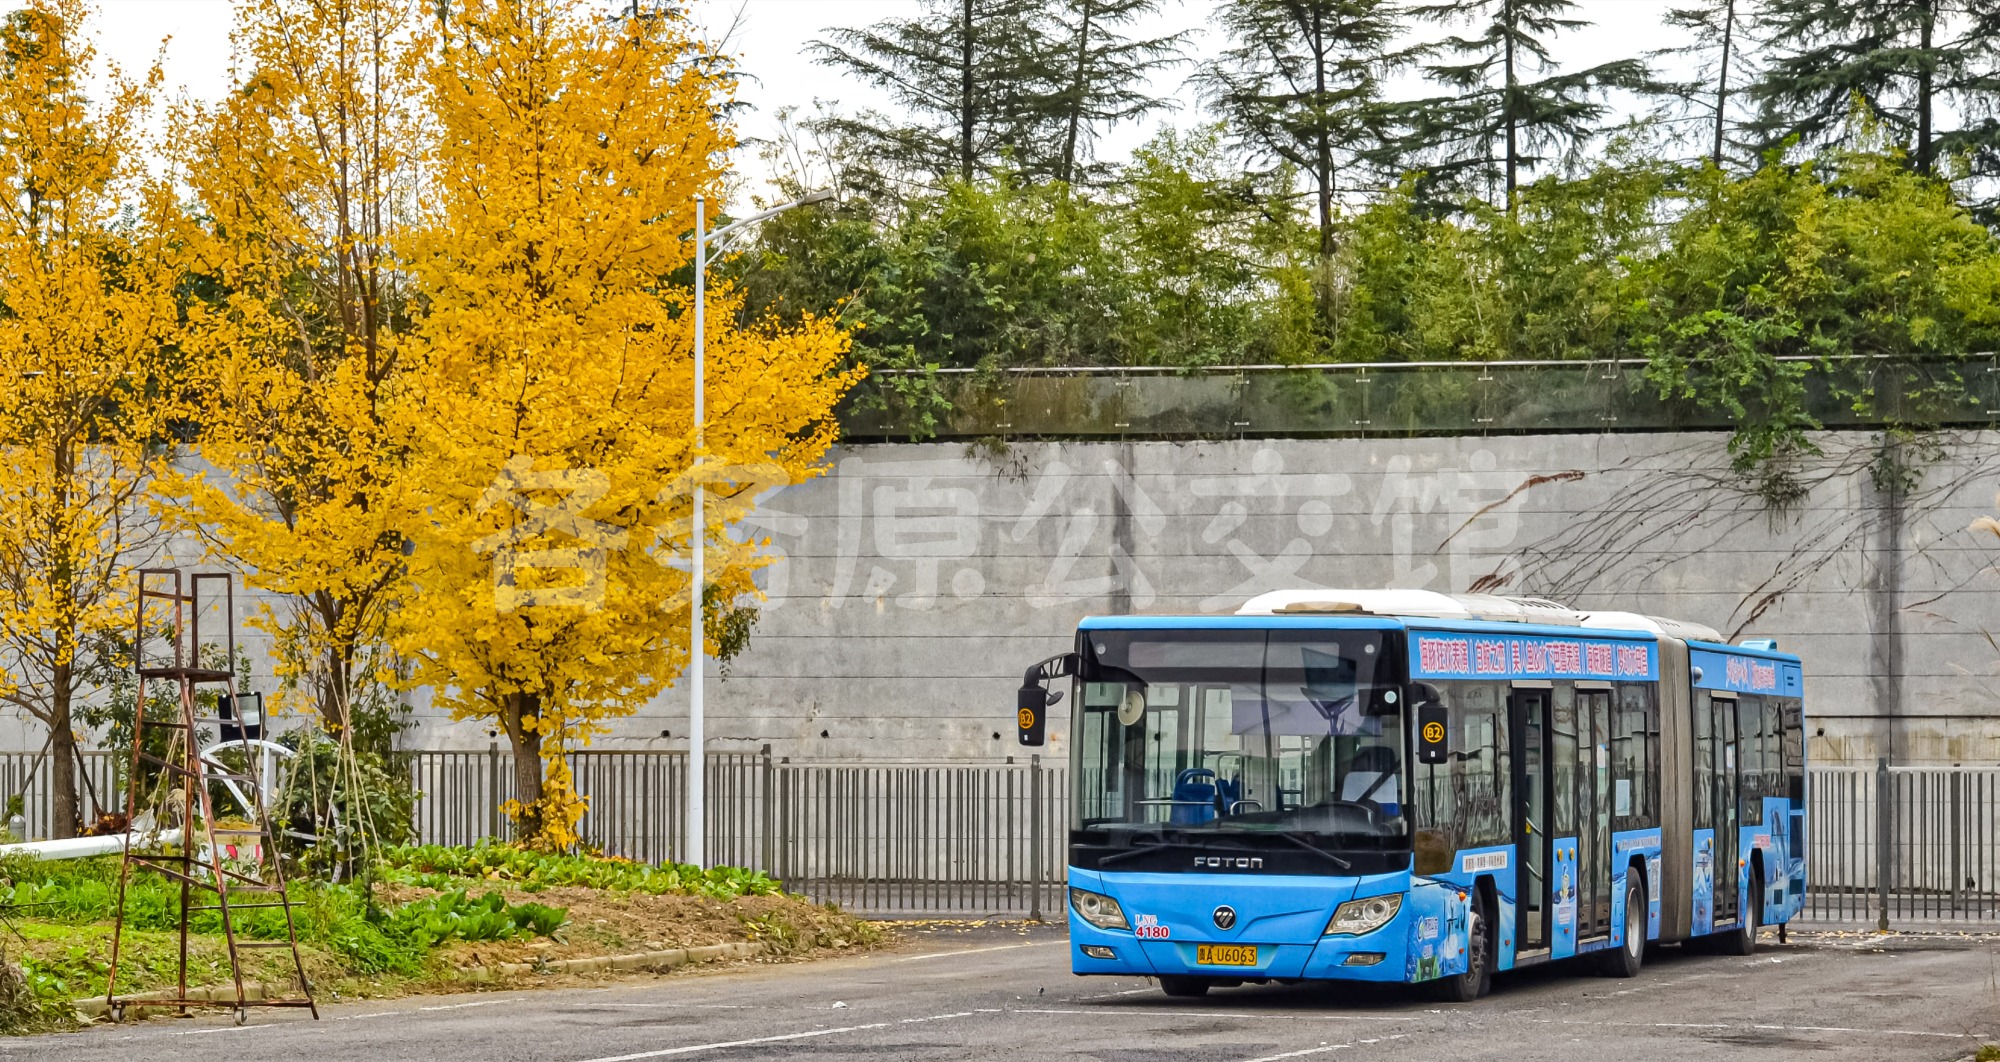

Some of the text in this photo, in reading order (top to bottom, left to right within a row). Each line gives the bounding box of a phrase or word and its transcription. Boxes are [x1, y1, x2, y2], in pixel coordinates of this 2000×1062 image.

[1426, 727, 1441, 739] B2
[1194, 857, 1263, 868] FOTON
[1135, 914, 1158, 926] LNG
[1135, 926, 1170, 938] 4180
